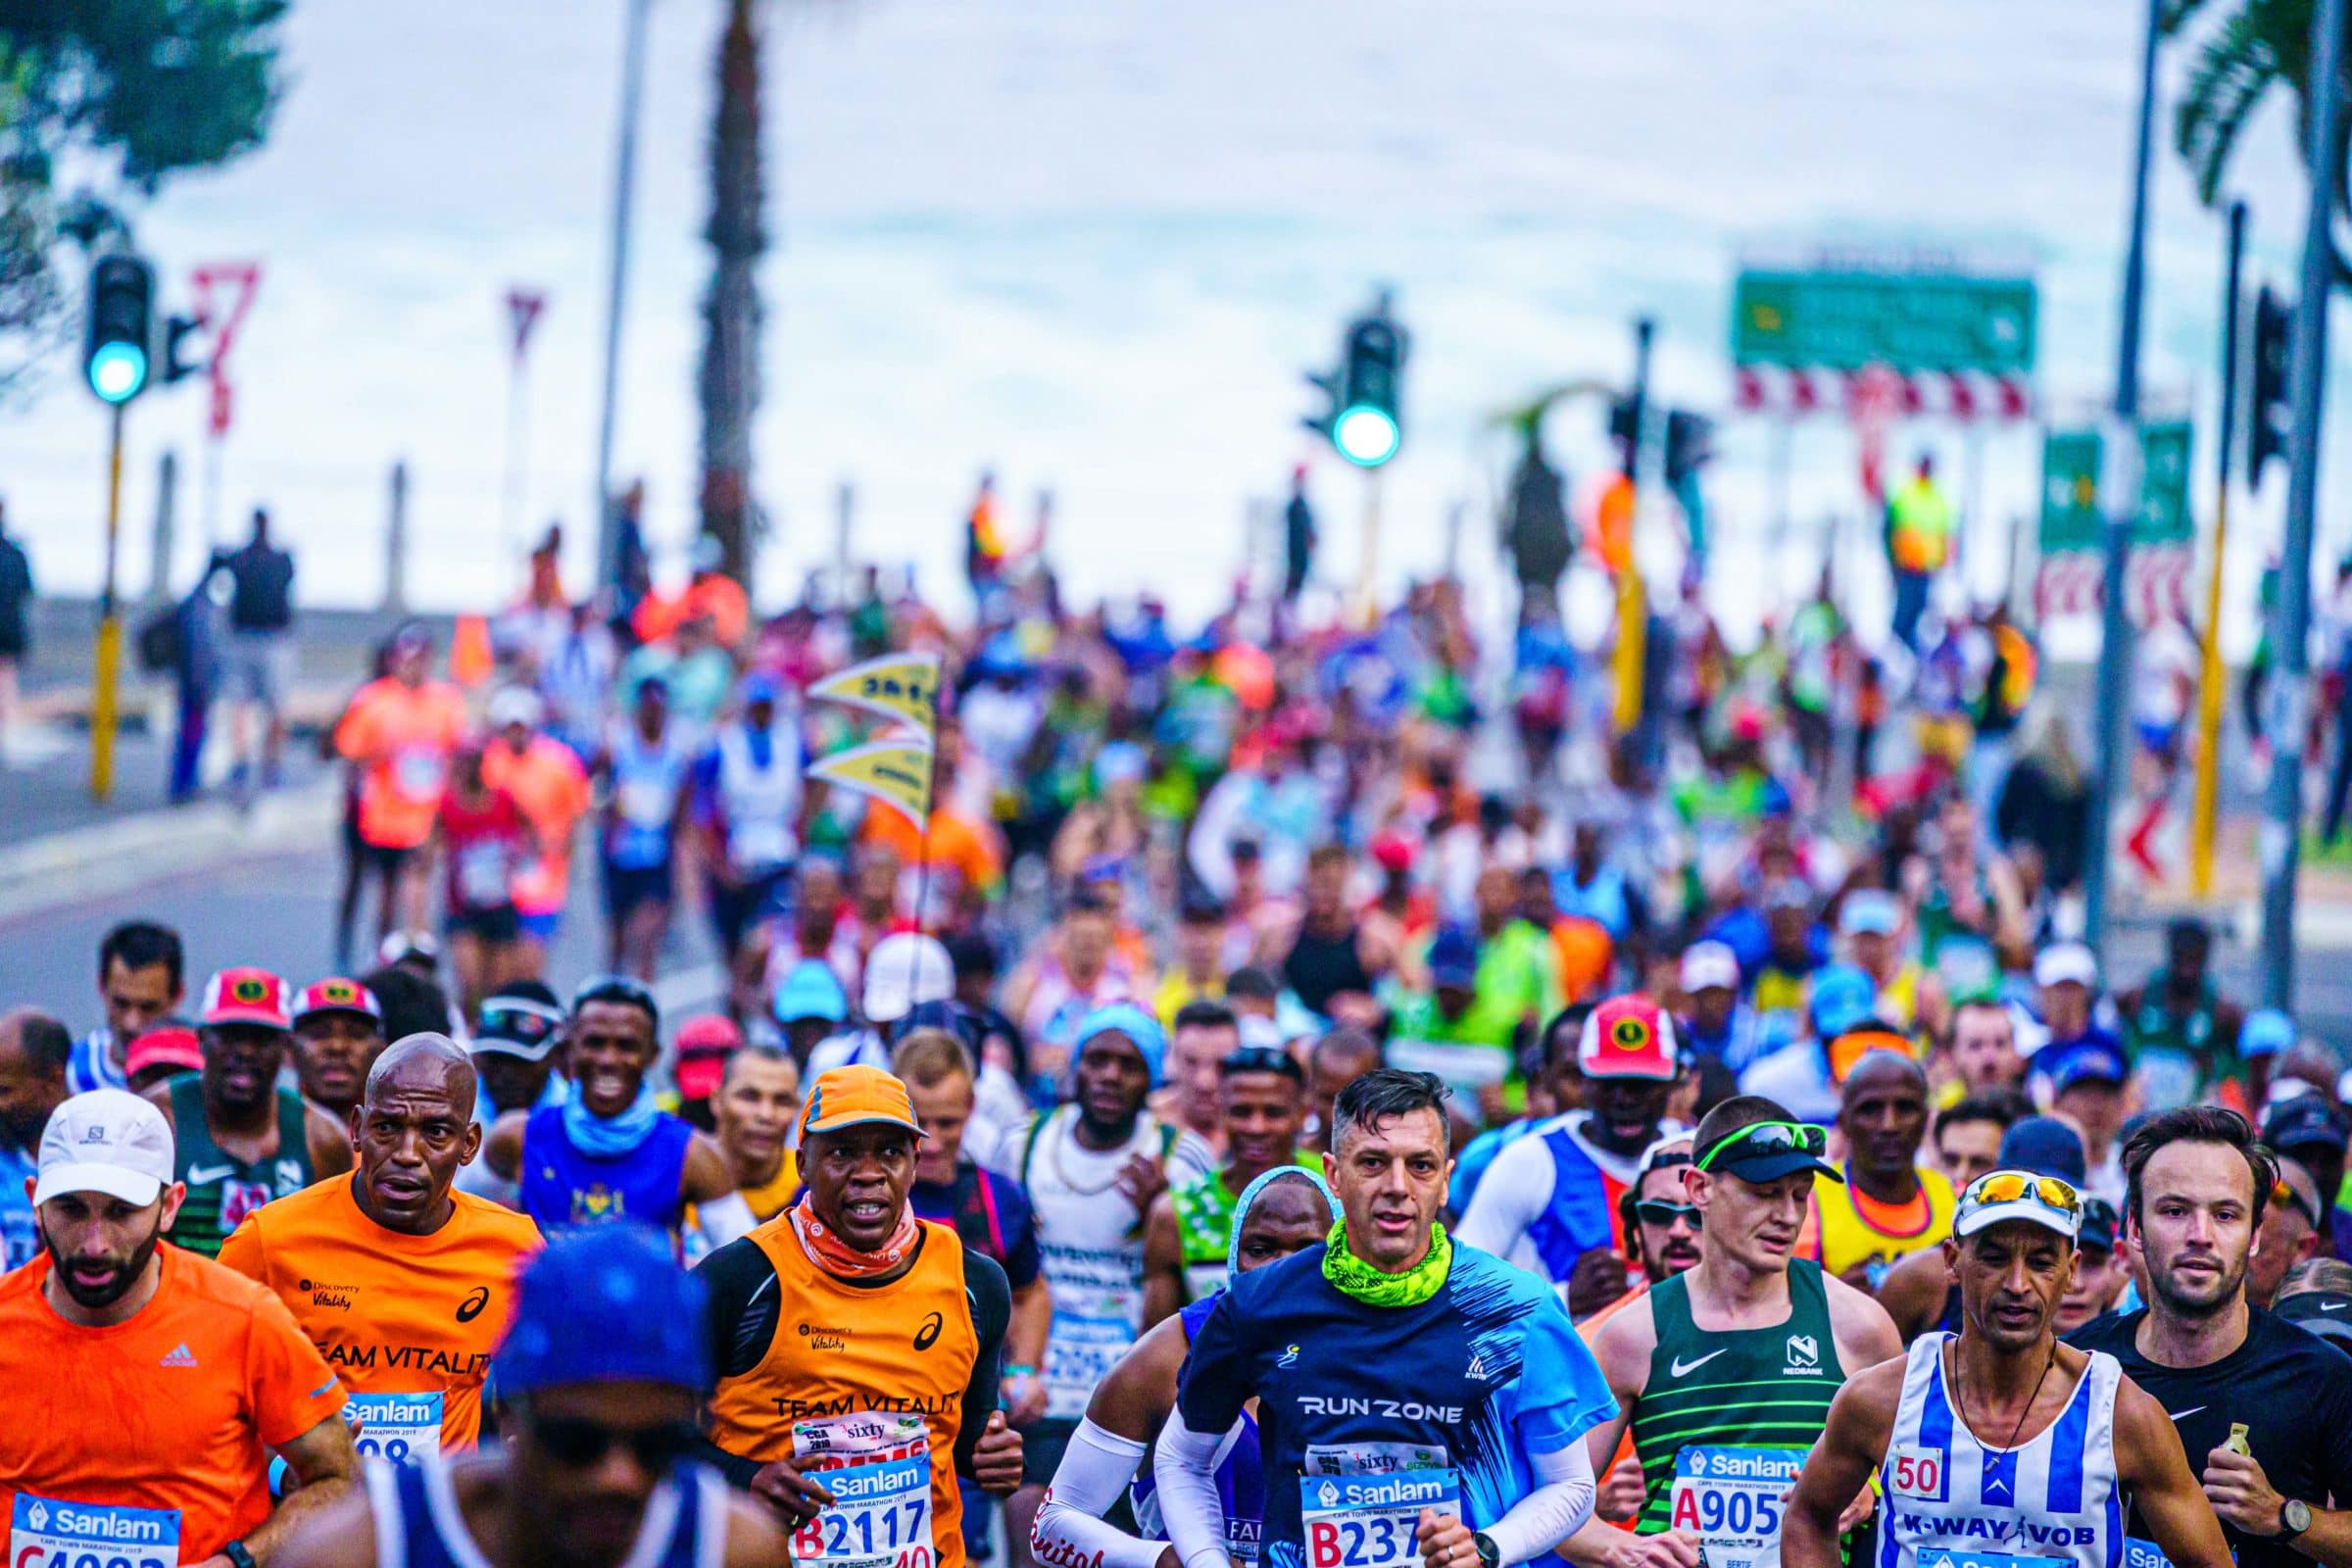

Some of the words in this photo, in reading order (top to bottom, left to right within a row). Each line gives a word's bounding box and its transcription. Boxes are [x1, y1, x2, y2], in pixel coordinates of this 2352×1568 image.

[313, 1281, 360, 1293] Discovery
[313, 1292, 352, 1311] Vitality
[314, 1340, 376, 1368] EAM
[384, 1346, 491, 1374] VITALIT
[810, 1335, 845, 1352] Vitality
[341, 1399, 430, 1422] Sanlam
[771, 1395, 855, 1418] TEAM
[862, 1391, 959, 1415] VITALIT
[1710, 1454, 1800, 1478] Sanlam
[1896, 1456, 1938, 1493] 50
[831, 1468, 918, 1497] Sanlam
[1346, 1479, 1443, 1505] Sanlam
[857, 1498, 894, 1509] MARATHON
[1673, 1488, 1779, 1535] A905
[56, 1509, 161, 1541] Sanlam
[795, 1498, 925, 1560] B2117
[1903, 1513, 2010, 1540] K-WAY
[2028, 1524, 2095, 1547] VOB
[82, 1543, 122, 1553] MARATHON
[1311, 1513, 1449, 1568] B237
